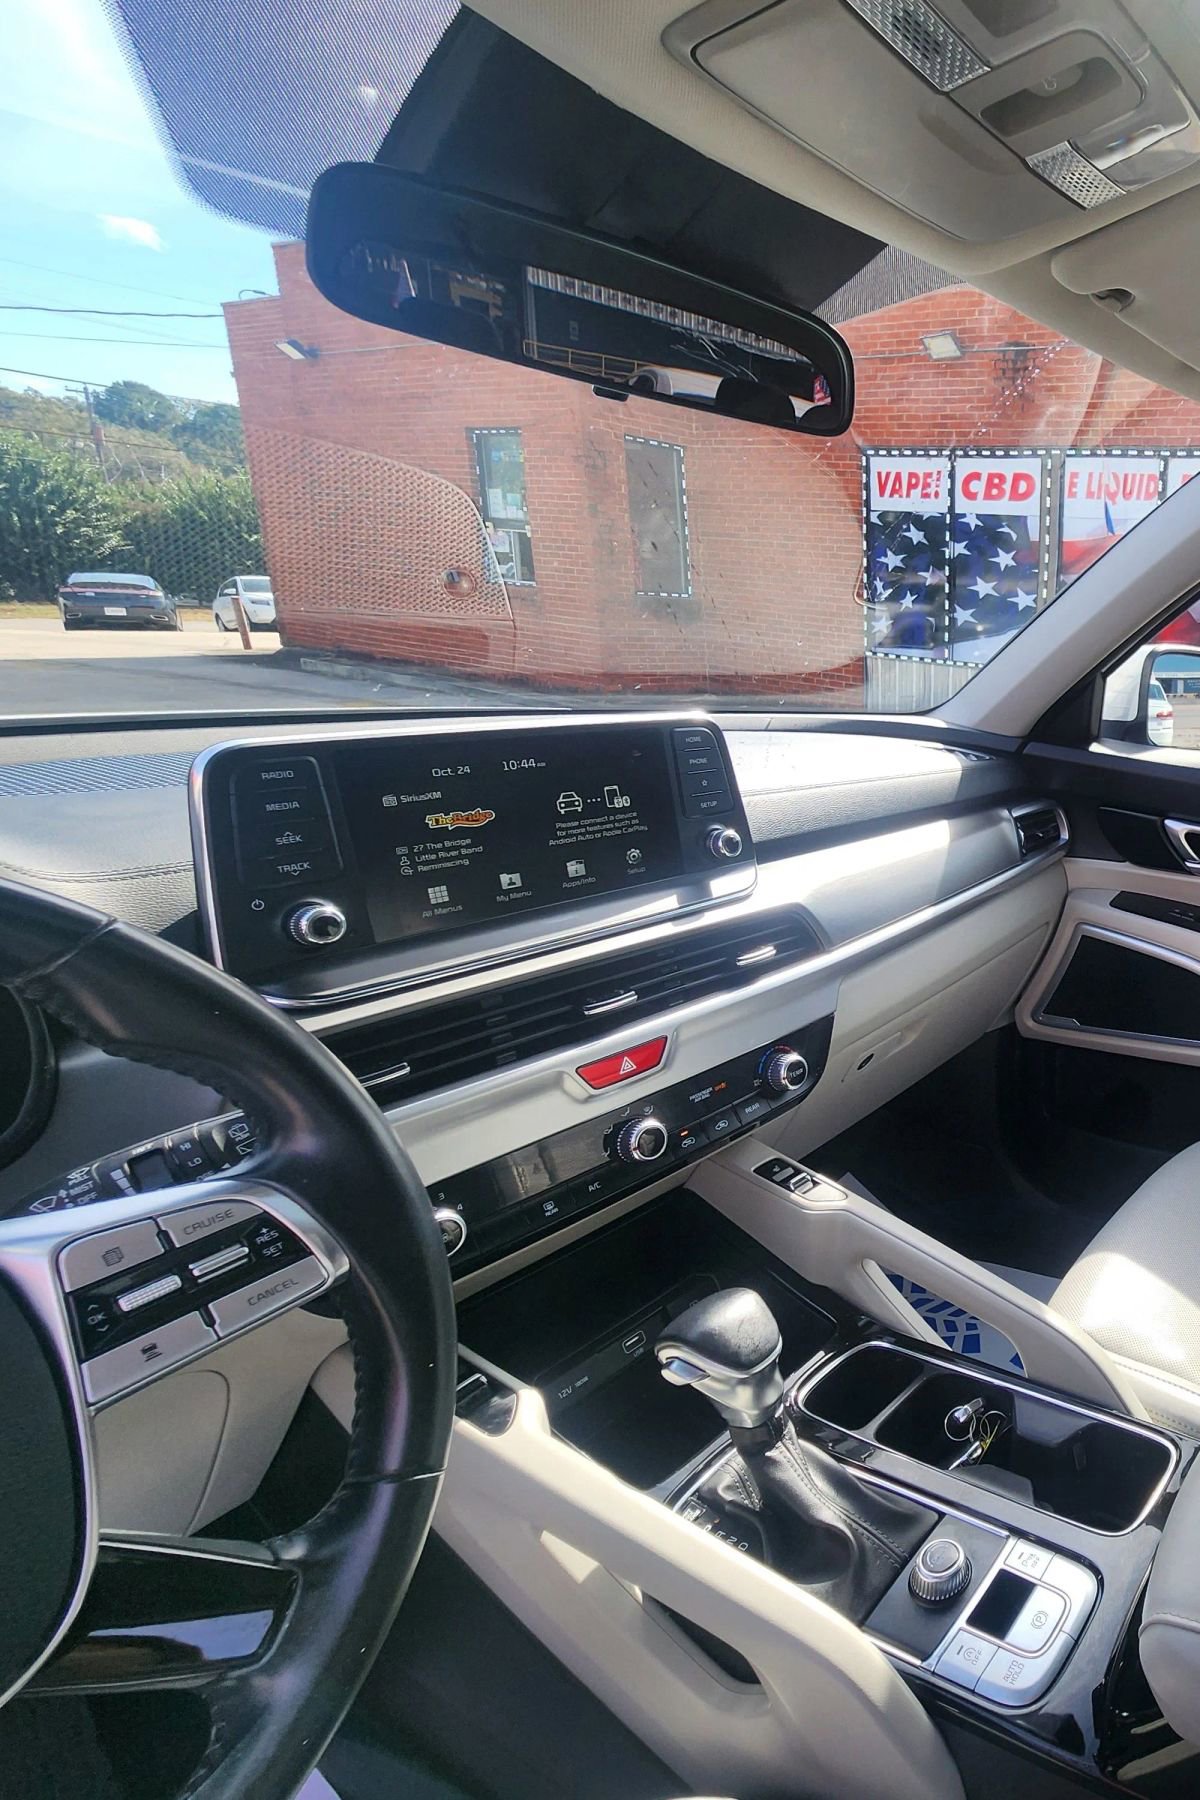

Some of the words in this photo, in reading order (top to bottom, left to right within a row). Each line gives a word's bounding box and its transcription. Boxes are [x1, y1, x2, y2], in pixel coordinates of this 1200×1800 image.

[876, 470, 942, 499] VAPE!
[961, 471, 1036, 502] CBD
[1067, 471, 1079, 499] E
[1085, 471, 1160, 505] LIQUID
[457, 766, 471, 775] 24
[502, 758, 536, 771] 10:44
[261, 770, 294, 780] RADIO
[400, 791, 442, 803] SiriusXM
[265, 801, 300, 811] MEDIA
[555, 821, 579, 829] Please
[580, 815, 608, 825] connect
[615, 812, 637, 820] device
[587, 823, 614, 832] features
[275, 834, 302, 845] SEEK
[549, 836, 577, 846] Android
[577, 833, 594, 841] Auto
[602, 829, 622, 837] Apple
[413, 844, 424, 853] 27
[426, 842, 443, 850] The
[444, 838, 472, 848] Bridge
[414, 852, 437, 863] Little
[438, 850, 459, 859] River
[460, 845, 483, 855] Band
[277, 862, 311, 873] TRACK
[417, 858, 470, 873] Reminiscing
[627, 866, 646, 875] Setup
[562, 876, 597, 888] Apps/Info
[496, 894, 509, 903] My
[509, 890, 532, 900] Menu
[434, 904, 463, 916] Menus
[744, 1102, 760, 1114] REAR
[180, 1142, 191, 1152] HI
[187, 1157, 202, 1168] LO
[69, 1180, 94, 1197] MIST
[588, 1181, 602, 1192] A/C
[77, 1191, 98, 1205] OFF
[438, 1192, 445, 1200] 3
[183, 1208, 235, 1236] CRUISE
[255, 1229, 280, 1245] RES
[262, 1241, 283, 1257] SET
[247, 1278, 299, 1306] CANCEL
[87, 1312, 108, 1325] OK
[558, 1385, 573, 1399] 12V
[737, 1542, 749, 1551] D
[971, 1649, 983, 1666] OFF
[1003, 1659, 1019, 1682] AUTO
[1010, 1663, 1025, 1685] HOLD
